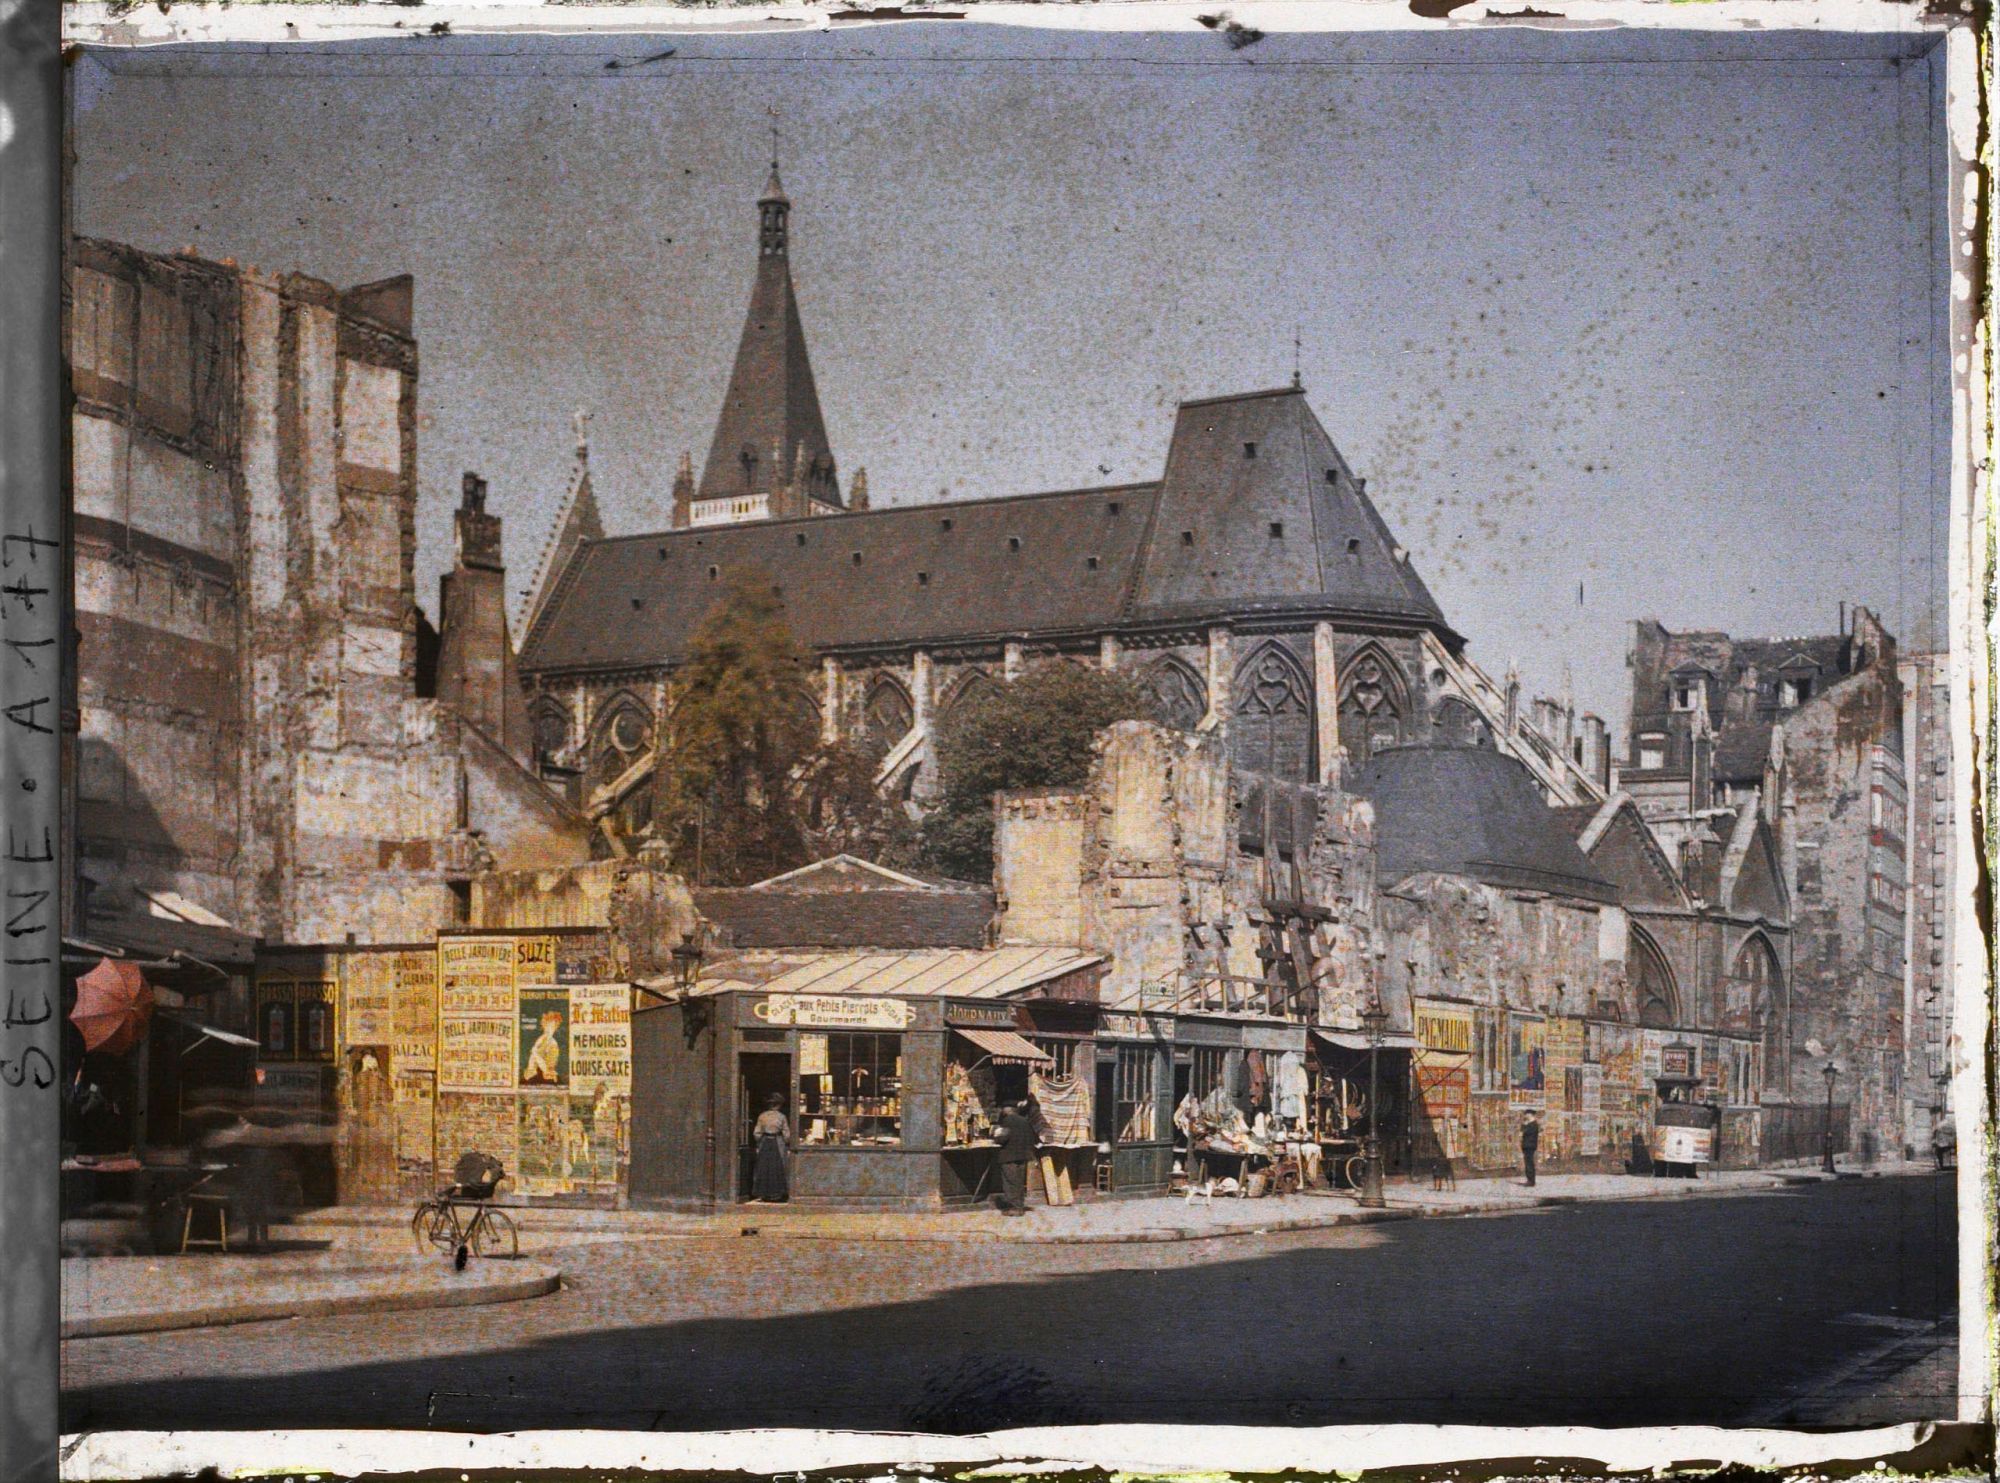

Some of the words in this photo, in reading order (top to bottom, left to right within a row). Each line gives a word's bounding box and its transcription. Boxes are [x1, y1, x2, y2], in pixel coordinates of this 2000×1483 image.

[1, 826, 55, 1089] SEINE
[444, 945, 467, 963] BELLE
[517, 942, 552, 965] SUZE
[589, 1002, 630, 1025] Matin
[799, 1000, 814, 1012] aux
[815, 998, 840, 1013] Petits
[841, 999, 878, 1015] Pierrots
[951, 1002, 1008, 1021] JOURNAUX
[809, 1013, 868, 1024] Gourmands
[444, 1019, 467, 1038] BELLE
[1418, 1016, 1470, 1050] PYGMALION
[391, 1044, 434, 1057] BALZAC
[571, 1059, 603, 1077] LOUISE
[605, 1058, 630, 1077] SAXE
